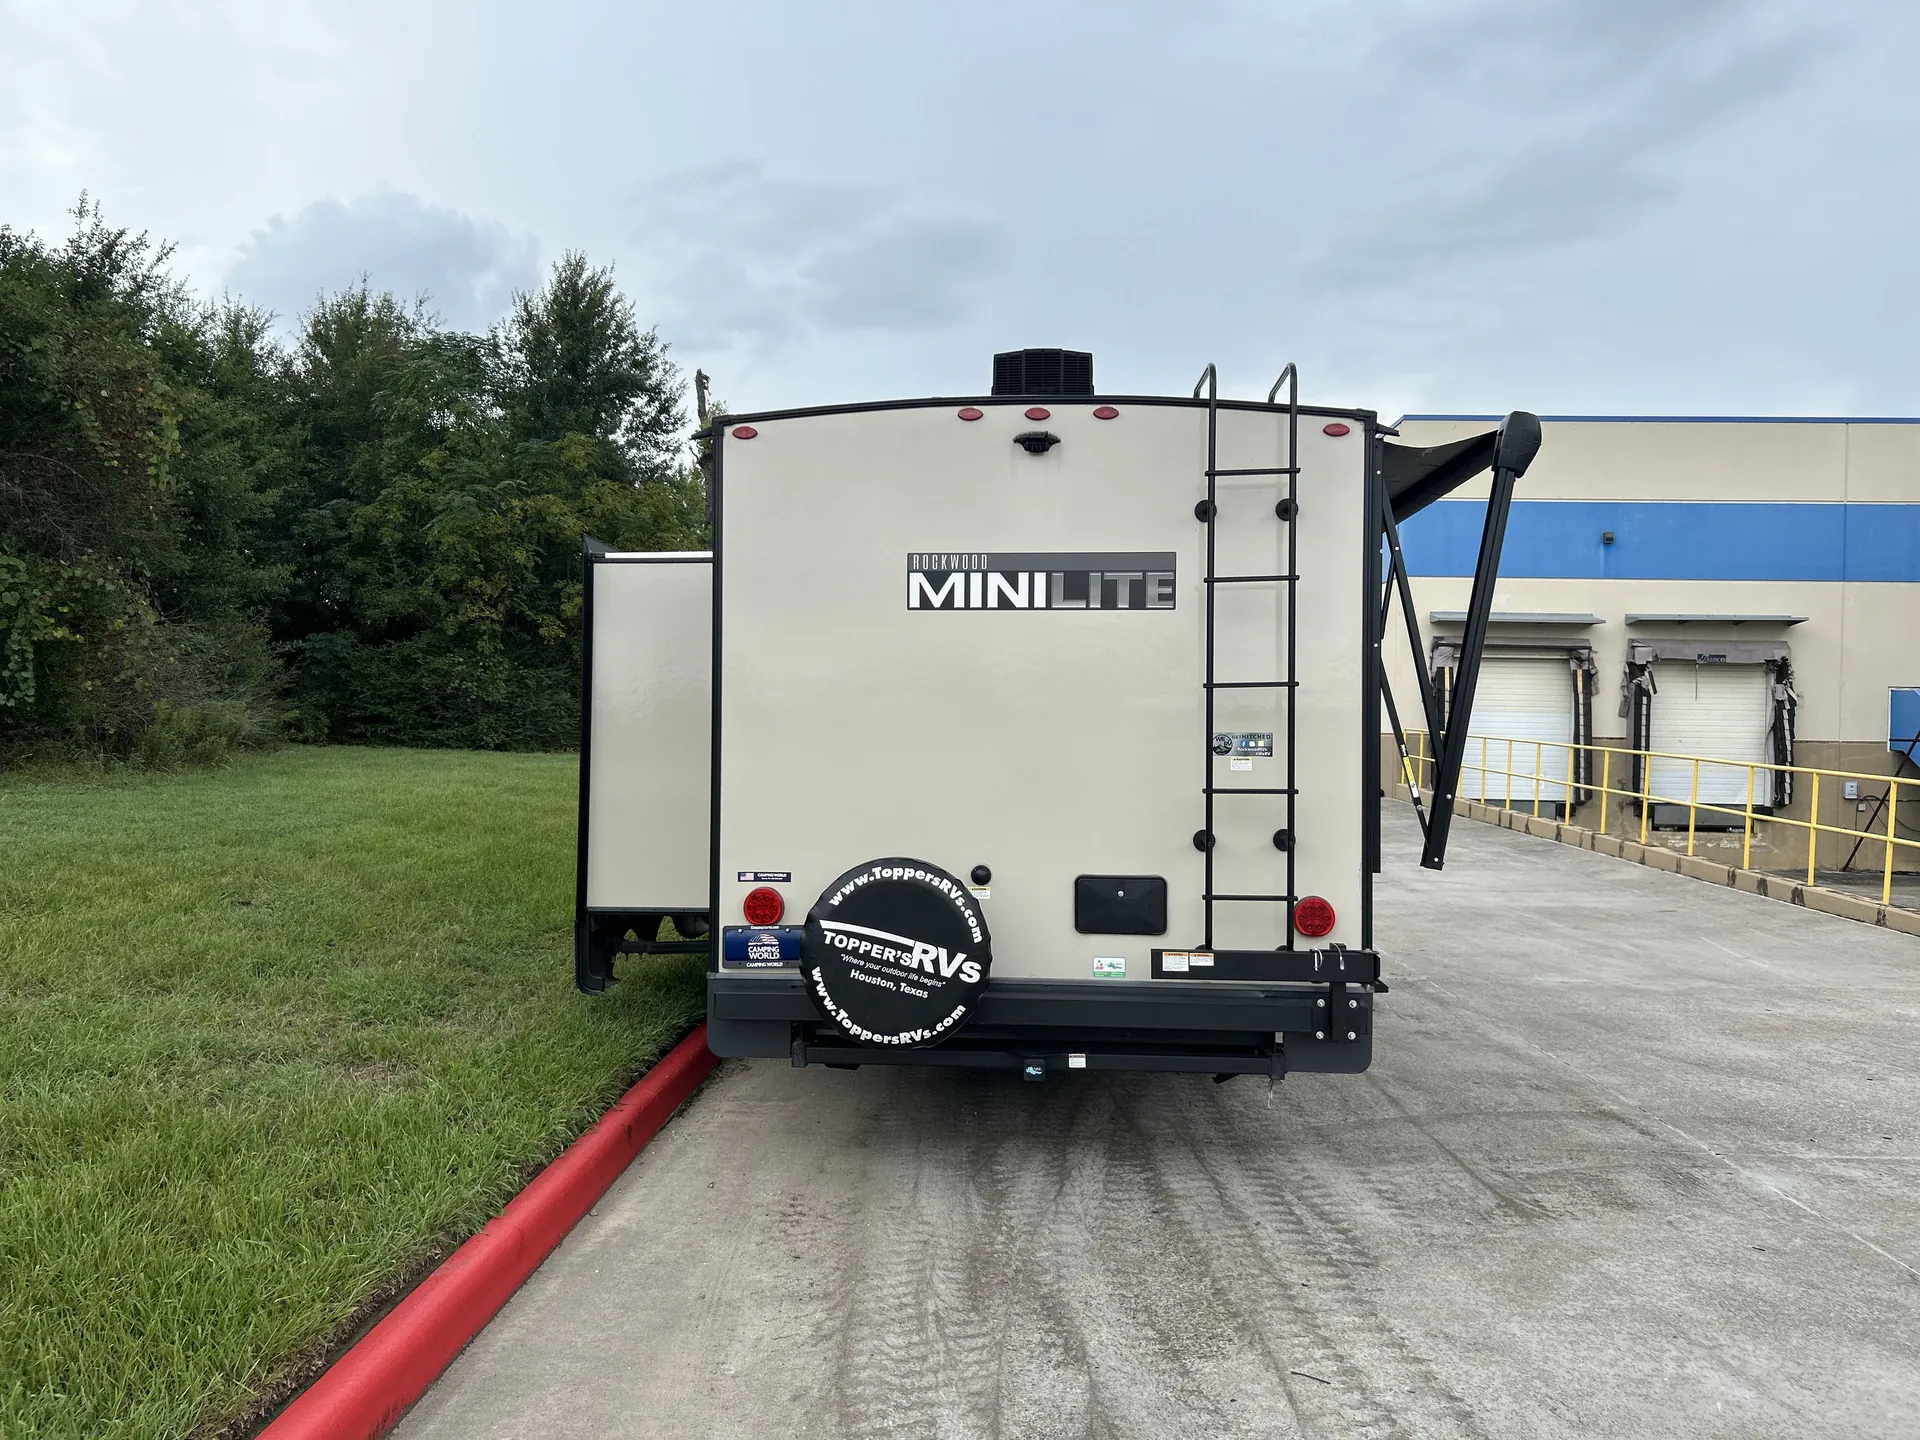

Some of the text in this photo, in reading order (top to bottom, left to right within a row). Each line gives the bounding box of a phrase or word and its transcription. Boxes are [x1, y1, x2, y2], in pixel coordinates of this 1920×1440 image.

[912, 554, 989, 570] ROCKWOOD
[829, 866, 983, 944] www.ToppersRVs.com
[748, 952, 780, 960] WORLD
[849, 968, 929, 999] Houston, Texas
[865, 961, 882, 970] your
[881, 965, 908, 978] outdoor
[908, 971, 919, 981] life
[811, 966, 967, 1045] www.ToppersRVs.com
